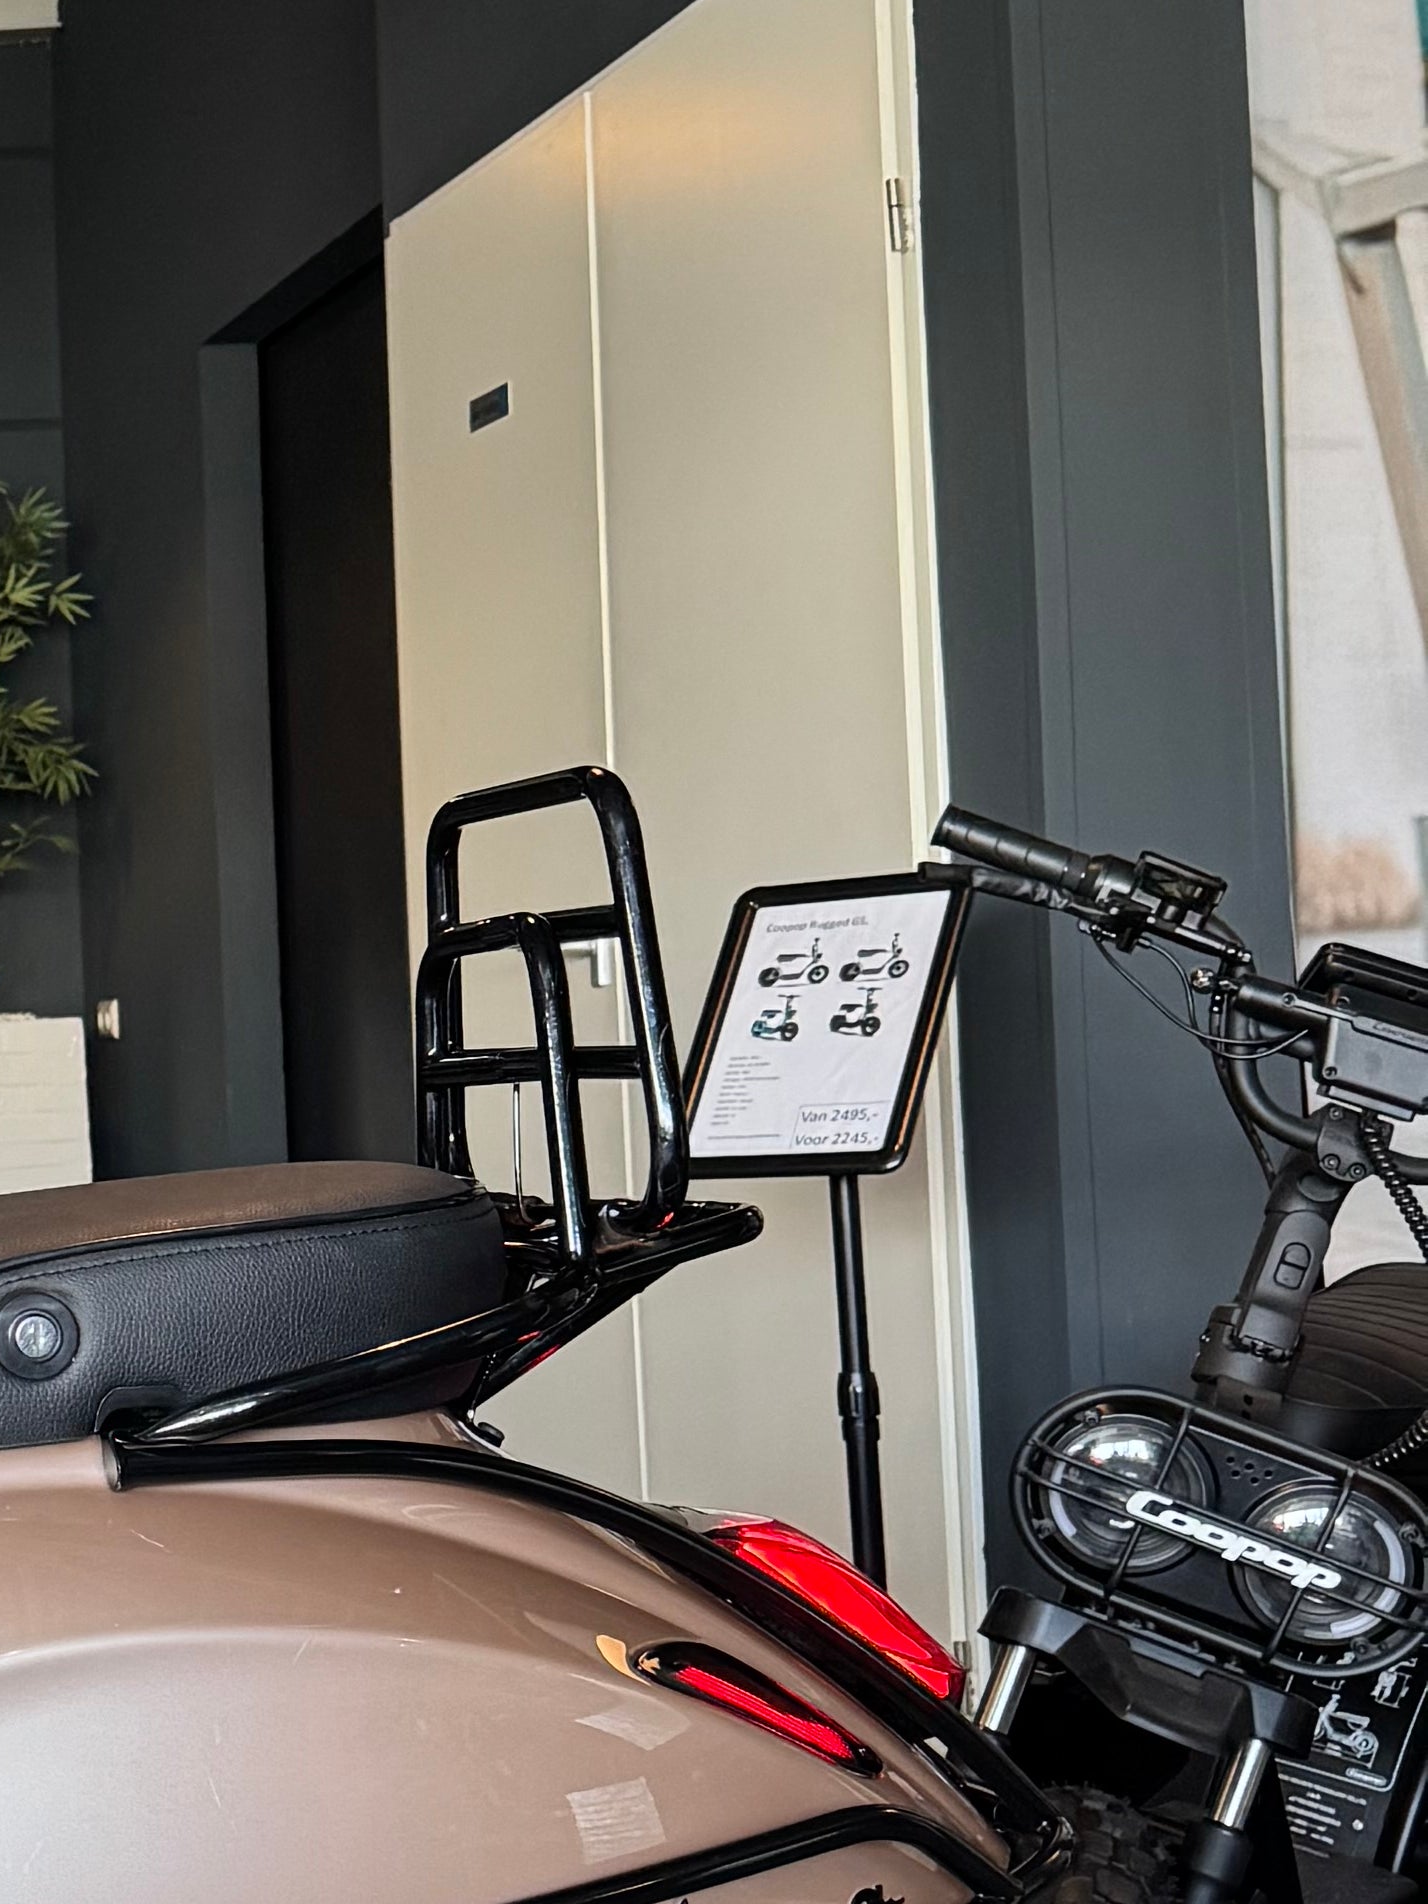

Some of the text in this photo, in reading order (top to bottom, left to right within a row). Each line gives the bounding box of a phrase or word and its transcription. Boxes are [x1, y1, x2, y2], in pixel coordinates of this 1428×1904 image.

[801, 1108, 880, 1123] Van 2495,-
[795, 1135, 828, 1146] Voor
[831, 1131, 880, 1145] 2245,-
[1125, 1490, 1342, 1589] Coopop
